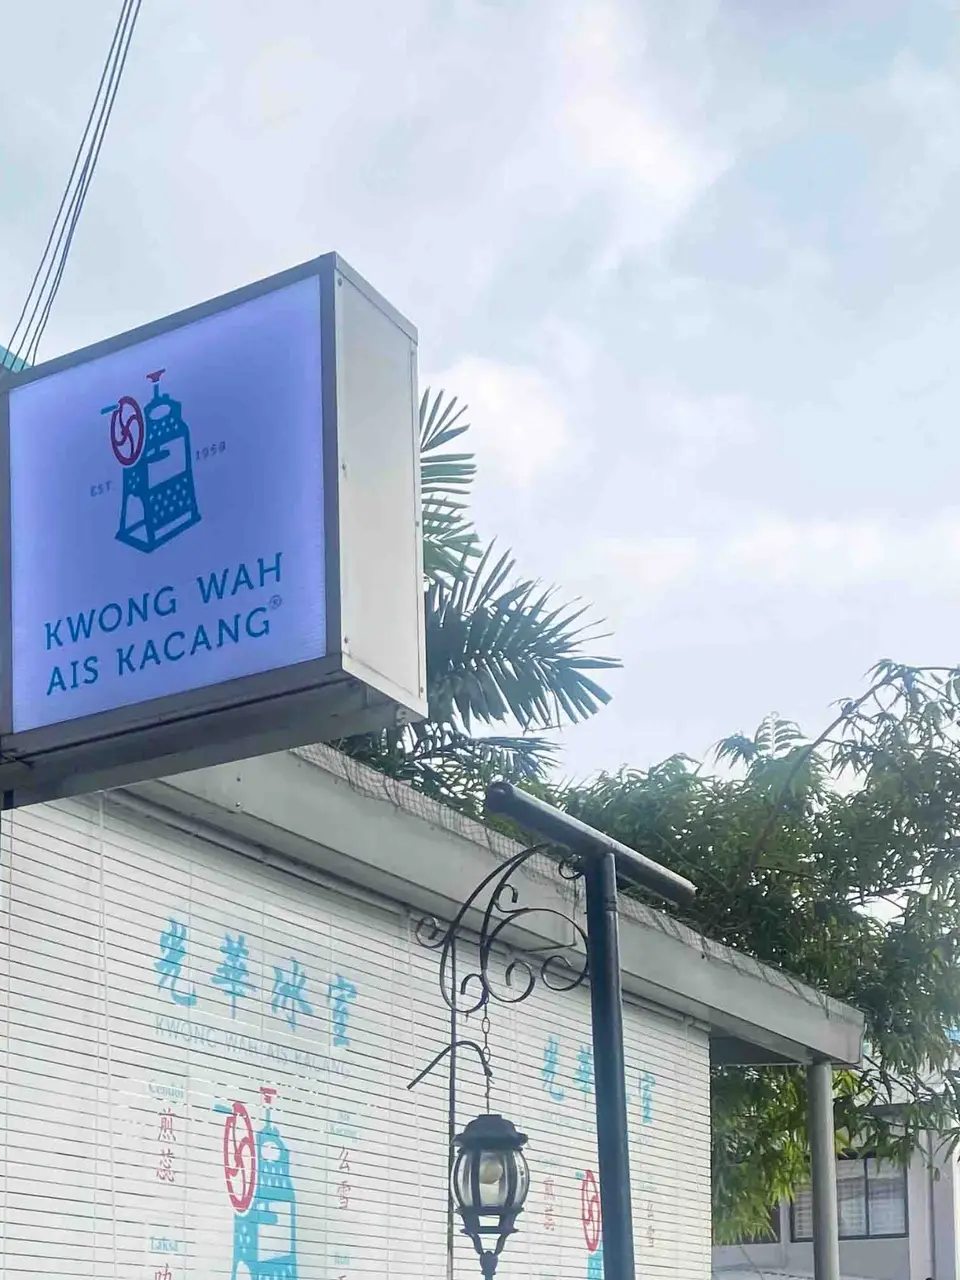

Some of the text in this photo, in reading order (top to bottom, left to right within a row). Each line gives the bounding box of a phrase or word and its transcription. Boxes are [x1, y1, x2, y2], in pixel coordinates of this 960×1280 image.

[44, 553, 283, 651] KWONG WAH
[46, 656, 99, 696] AIS
